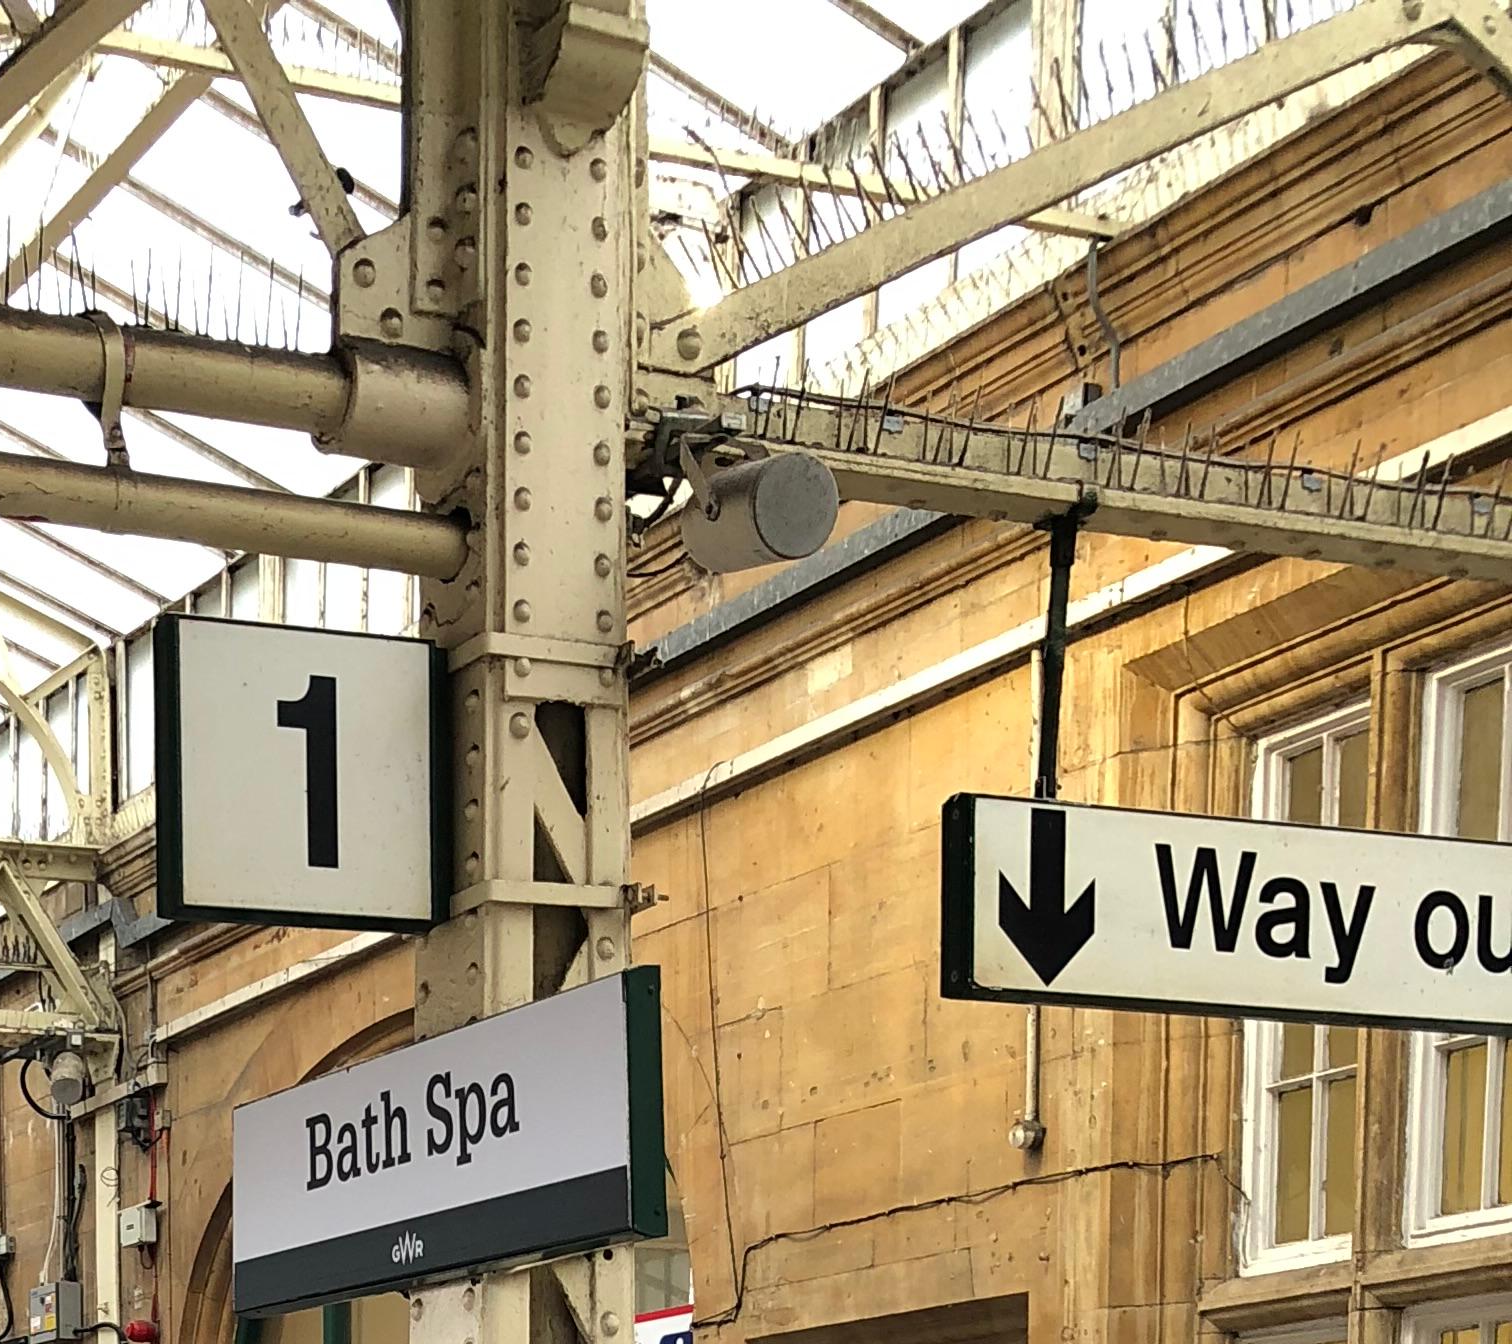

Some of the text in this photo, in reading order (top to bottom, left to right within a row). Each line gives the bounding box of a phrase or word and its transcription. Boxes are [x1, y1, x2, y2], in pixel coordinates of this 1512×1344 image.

[276, 673, 340, 870] 1
[1154, 842, 1377, 986] Way
[306, 1069, 521, 1192] Bath Spa
[391, 1230, 424, 1265] GWR
